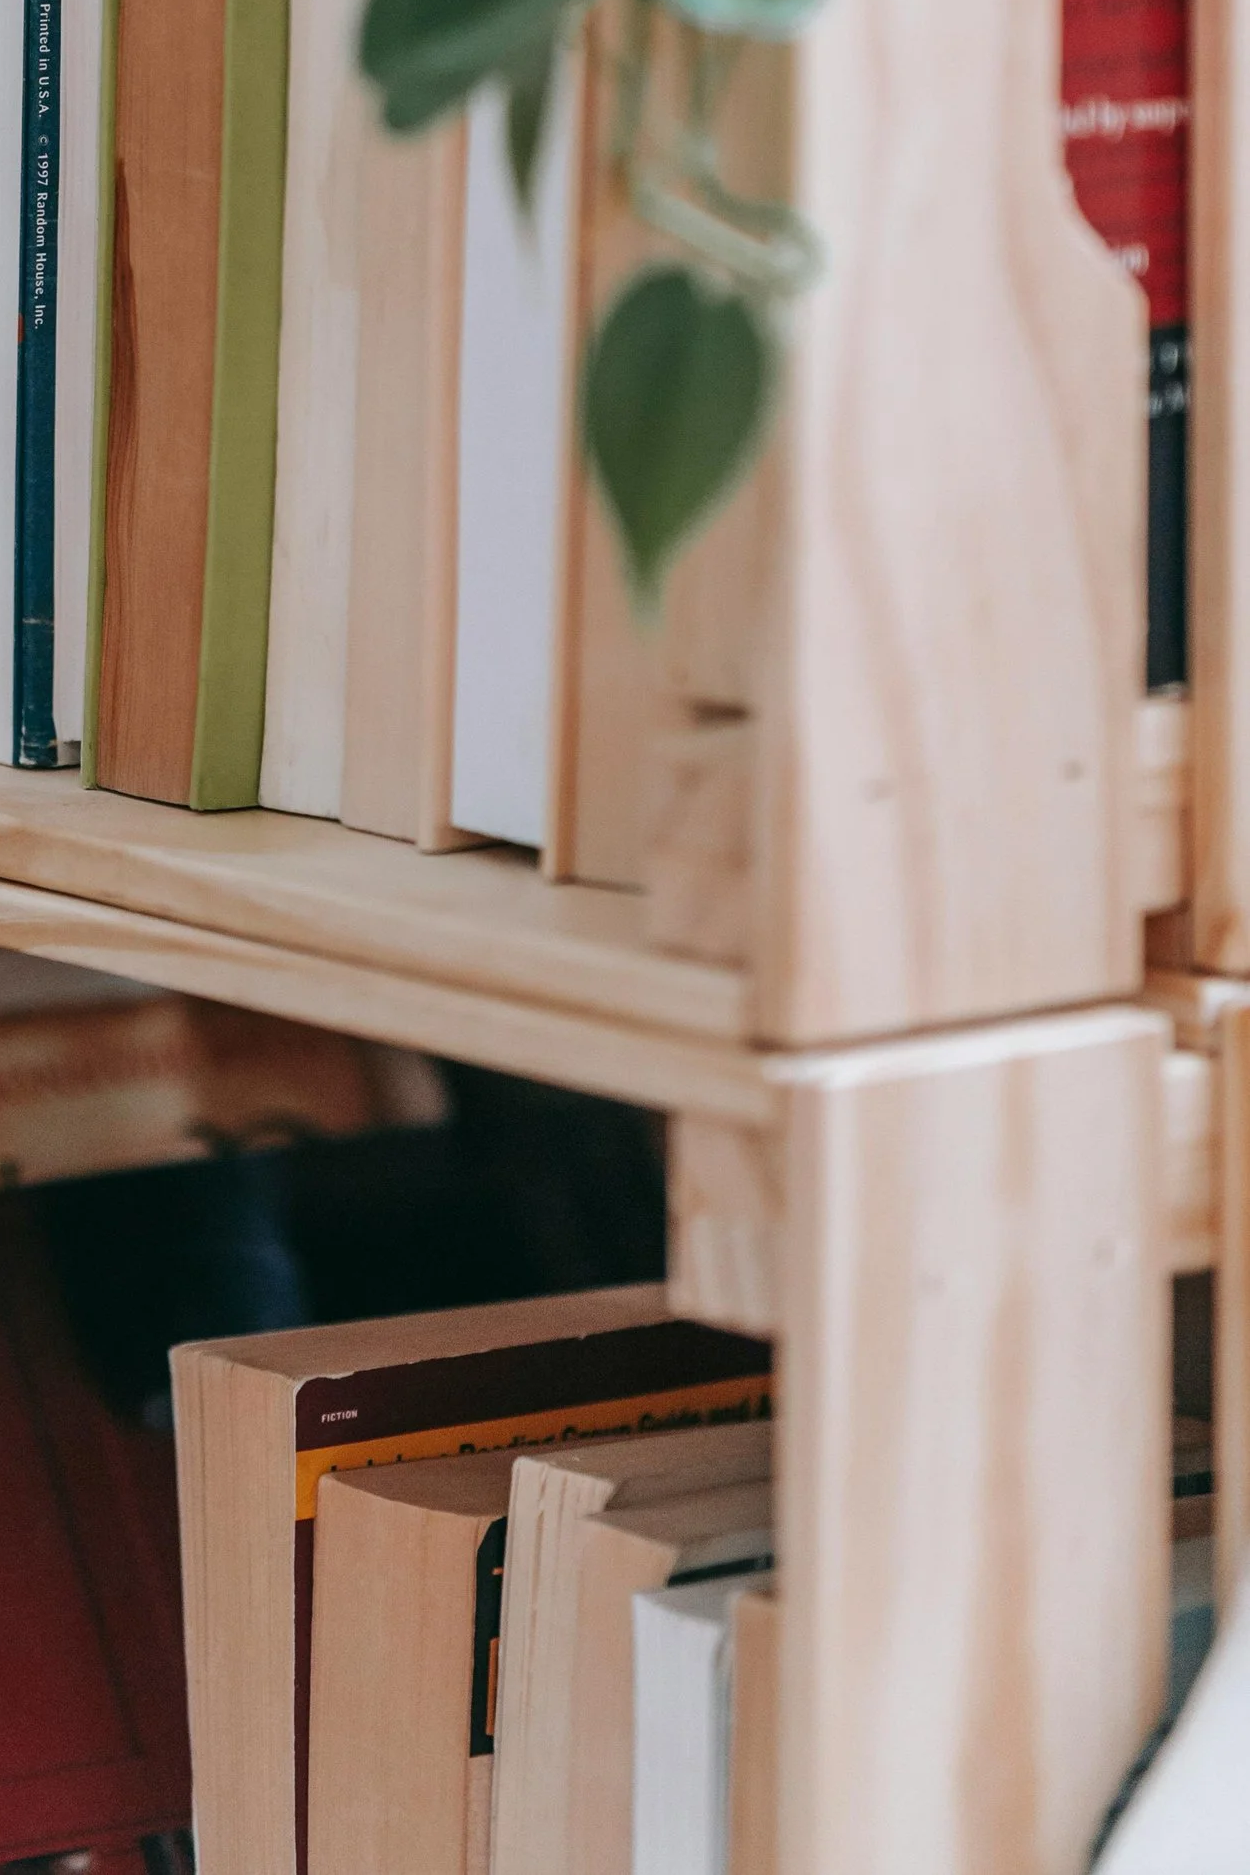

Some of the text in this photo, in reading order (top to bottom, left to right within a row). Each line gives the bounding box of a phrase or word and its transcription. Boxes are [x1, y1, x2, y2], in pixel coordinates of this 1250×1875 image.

[39, 3, 51, 53] Printed
[39, 58, 49, 72] in
[38, 76, 50, 118] U.S.A.
[38, 153, 49, 186] 1997
[35, 192, 48, 248] Random
[34, 252, 47, 299] House,
[34, 305, 46, 330] Inc.
[321, 1409, 358, 1424] FICTION
